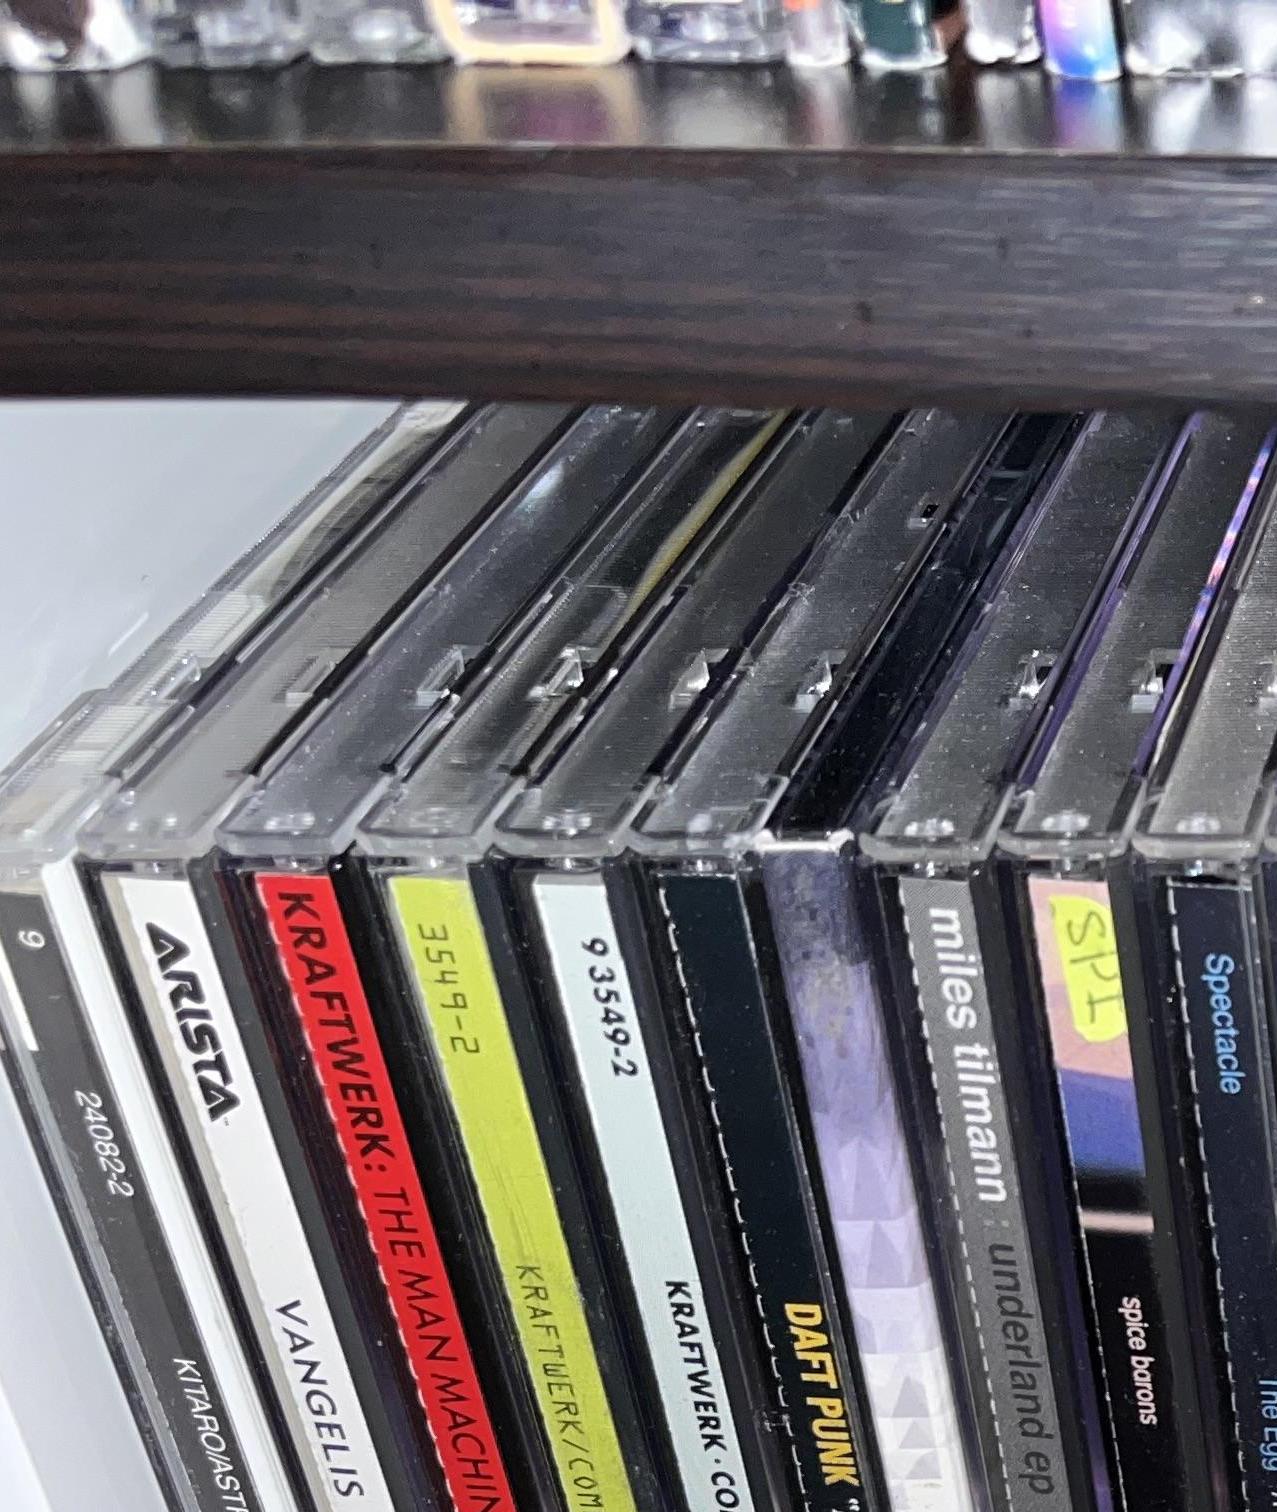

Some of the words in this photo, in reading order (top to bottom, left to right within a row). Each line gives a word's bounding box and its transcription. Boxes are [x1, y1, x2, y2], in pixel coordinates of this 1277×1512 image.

[145, 922, 241, 1119] ARISTA
[587, 965, 639, 1077] 3549-2
[928, 907, 979, 1030] miles
[1199, 952, 1247, 1095] Spectacle
[277, 892, 396, 1175] KRAFTWERK:
[73, 1089, 135, 1197] 24082-2
[952, 1042, 1008, 1202] tilmann
[373, 1186, 427, 1259] THE
[397, 1269, 459, 1363] MAN
[664, 1280, 728, 1452] KRAFTWERK
[783, 1302, 839, 1390] DAFT
[987, 1243, 1056, 1441] underland
[1116, 1296, 1150, 1352] spice
[275, 1299, 365, 1498] VANGELIS
[805, 1396, 860, 1488] PUNK
[1129, 1354, 1159, 1426] barons
[1017, 1450, 1056, 1496] ep
